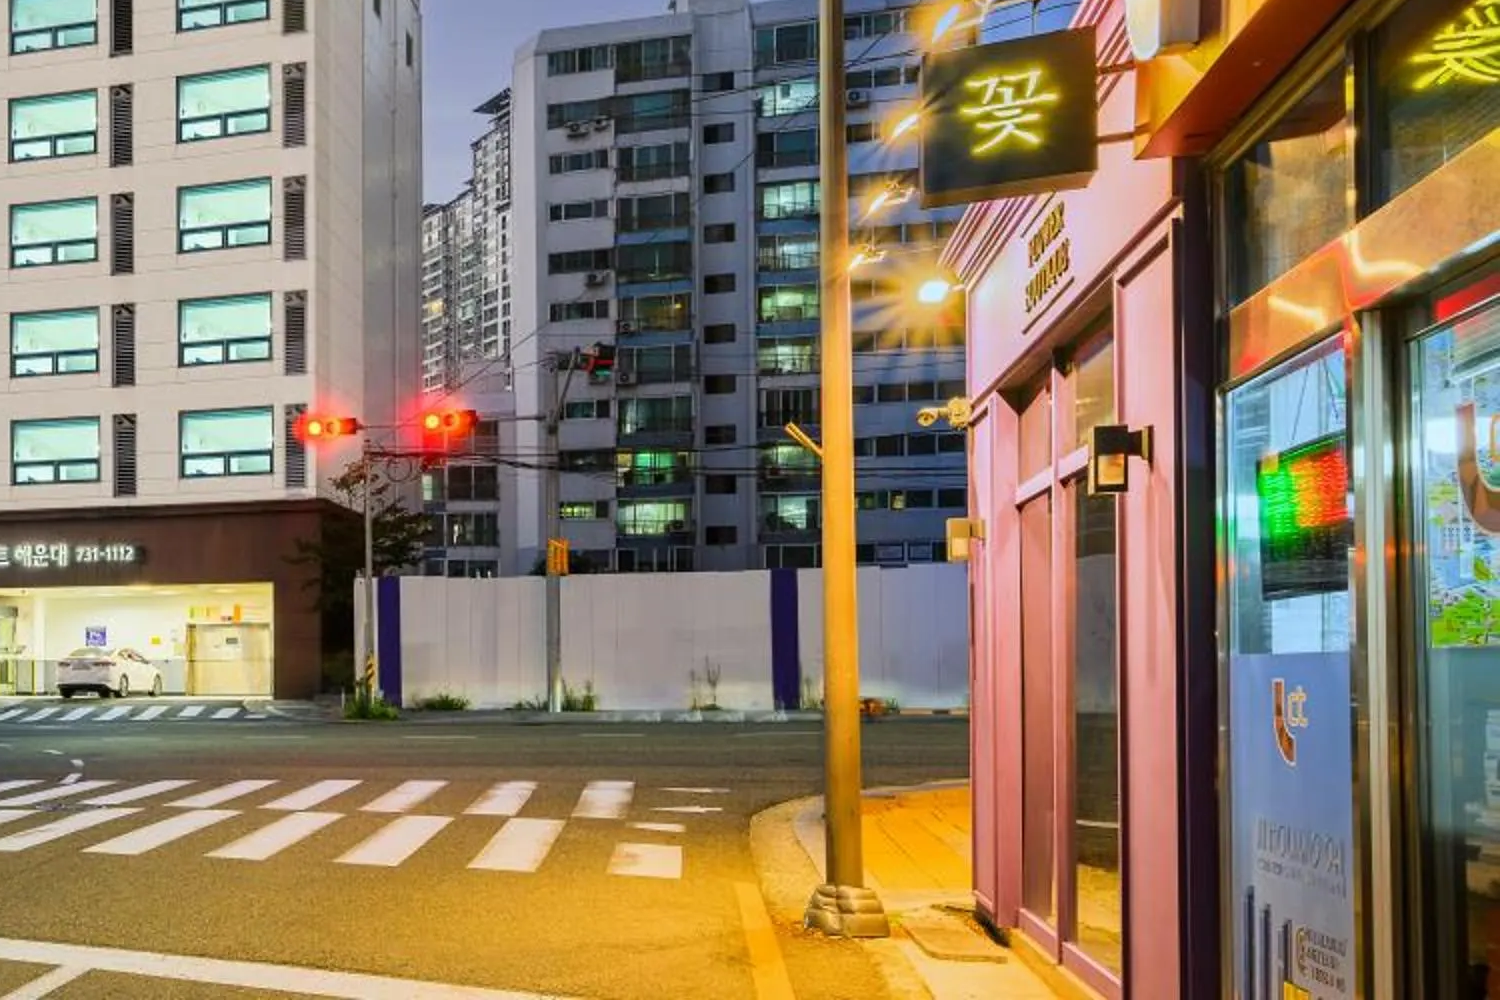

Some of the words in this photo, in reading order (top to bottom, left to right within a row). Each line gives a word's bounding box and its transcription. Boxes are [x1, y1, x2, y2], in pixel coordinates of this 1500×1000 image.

[960, 67, 1060, 154] 꽃
[14, 543, 68, 568] 해운대
[75, 546, 134, 562] 731-1112
